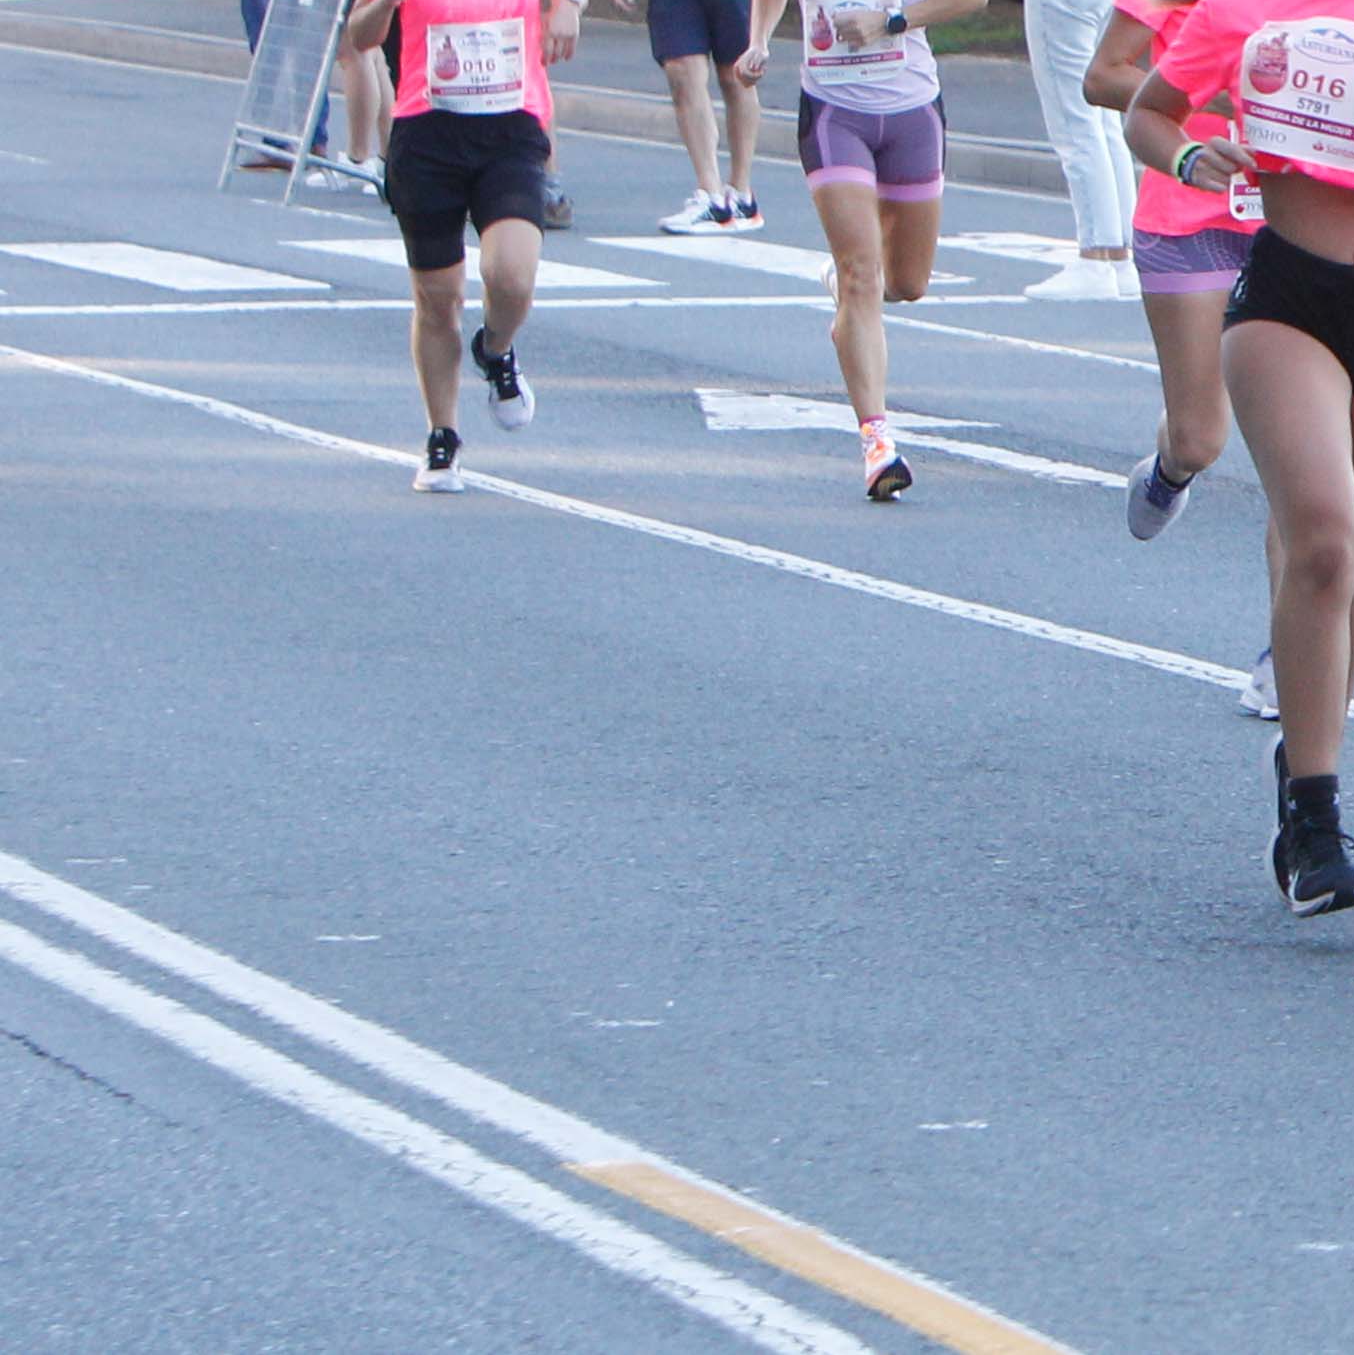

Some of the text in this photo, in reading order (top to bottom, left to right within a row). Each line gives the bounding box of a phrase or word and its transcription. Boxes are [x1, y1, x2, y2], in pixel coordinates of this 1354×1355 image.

[463, 58, 496, 73] 016
[1292, 69, 1347, 99] 016
[1297, 97, 1331, 116] 5791
